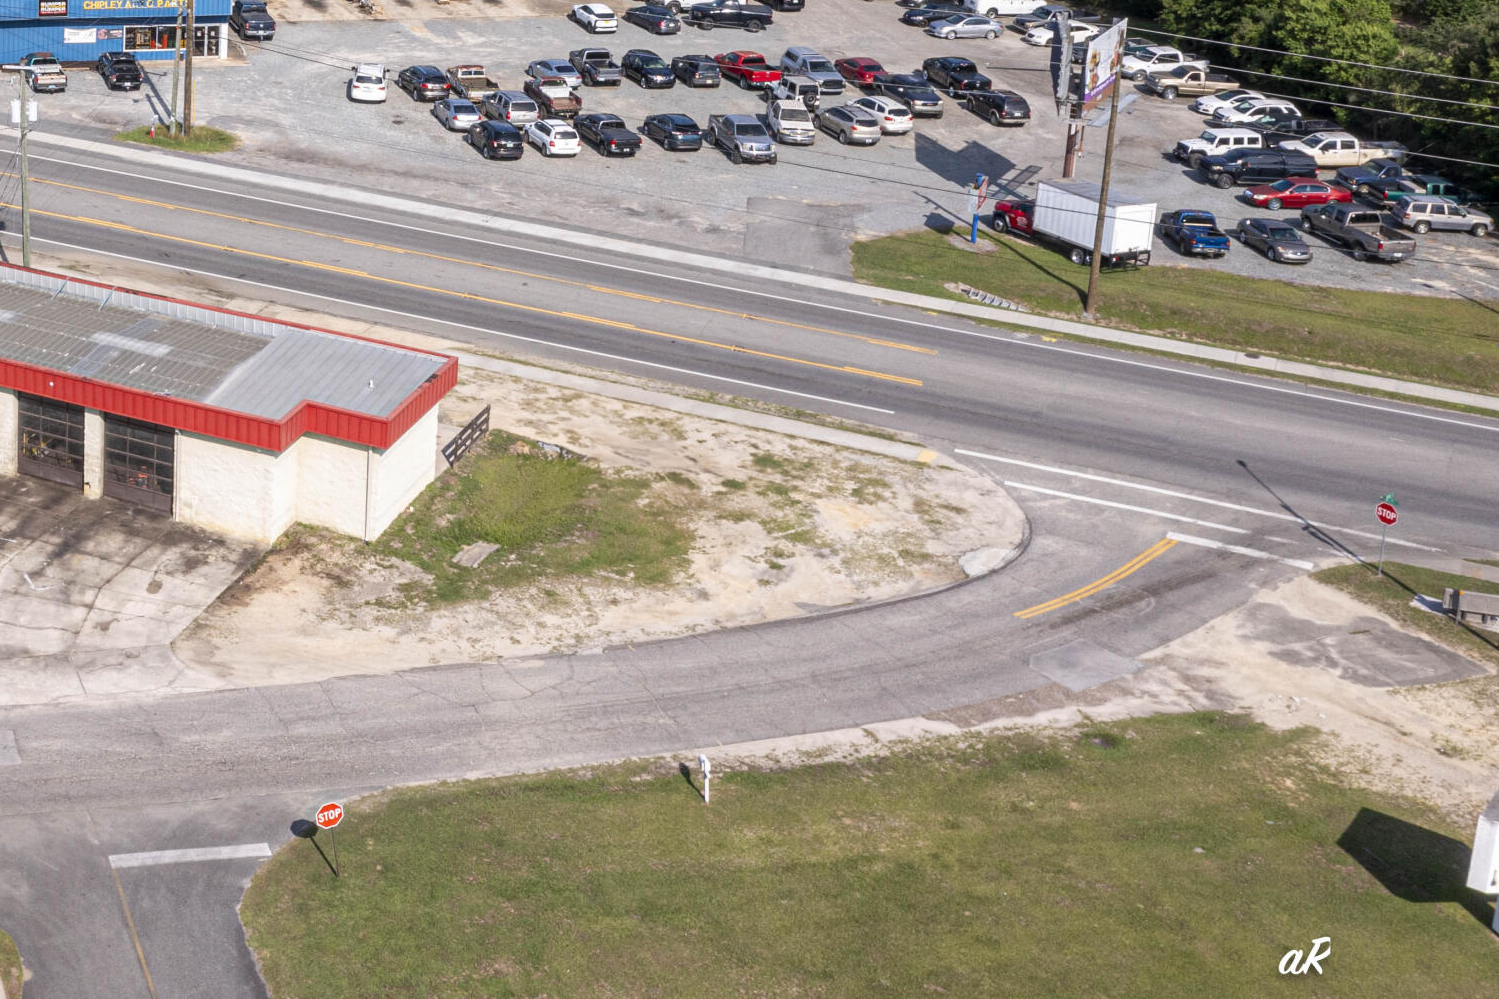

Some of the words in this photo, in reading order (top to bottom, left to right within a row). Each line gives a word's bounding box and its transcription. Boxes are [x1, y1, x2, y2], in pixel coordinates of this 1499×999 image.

[83, 0, 123, 10] CHIPLEY
[1377, 506, 1397, 520] STOP
[318, 808, 341, 823] STOP
